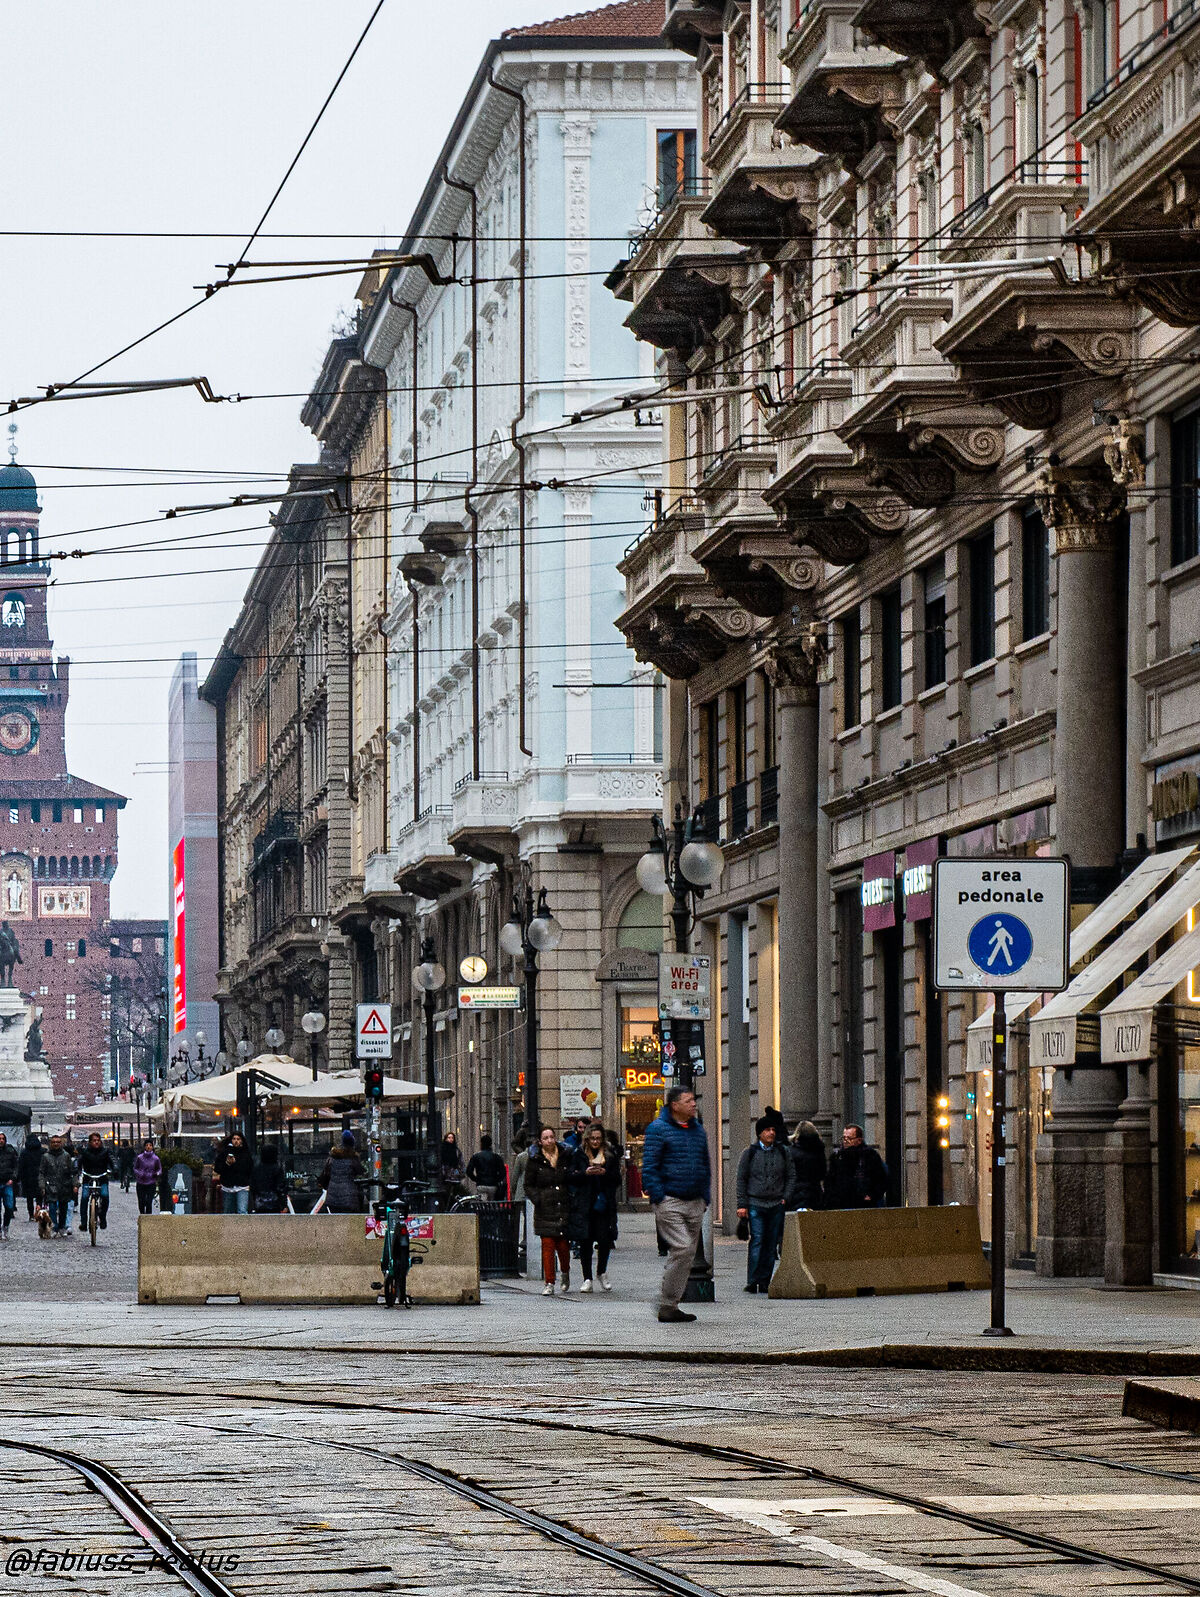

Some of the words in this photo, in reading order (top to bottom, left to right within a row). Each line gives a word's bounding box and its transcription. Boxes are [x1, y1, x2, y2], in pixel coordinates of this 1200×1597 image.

[903, 864, 928, 896] GUESS
[981, 870, 1022, 882] area
[861, 877, 884, 907] GUESS
[958, 888, 1044, 904] pedonale
[671, 966, 699, 980] Wi-Fi
[671, 981, 699, 991] area
[1042, 1030, 1066, 1058] MUSTO
[1114, 1023, 1142, 1054] MUSTO
[978, 1039, 993, 1065] MUS
[625, 1068, 658, 1085] Bar
